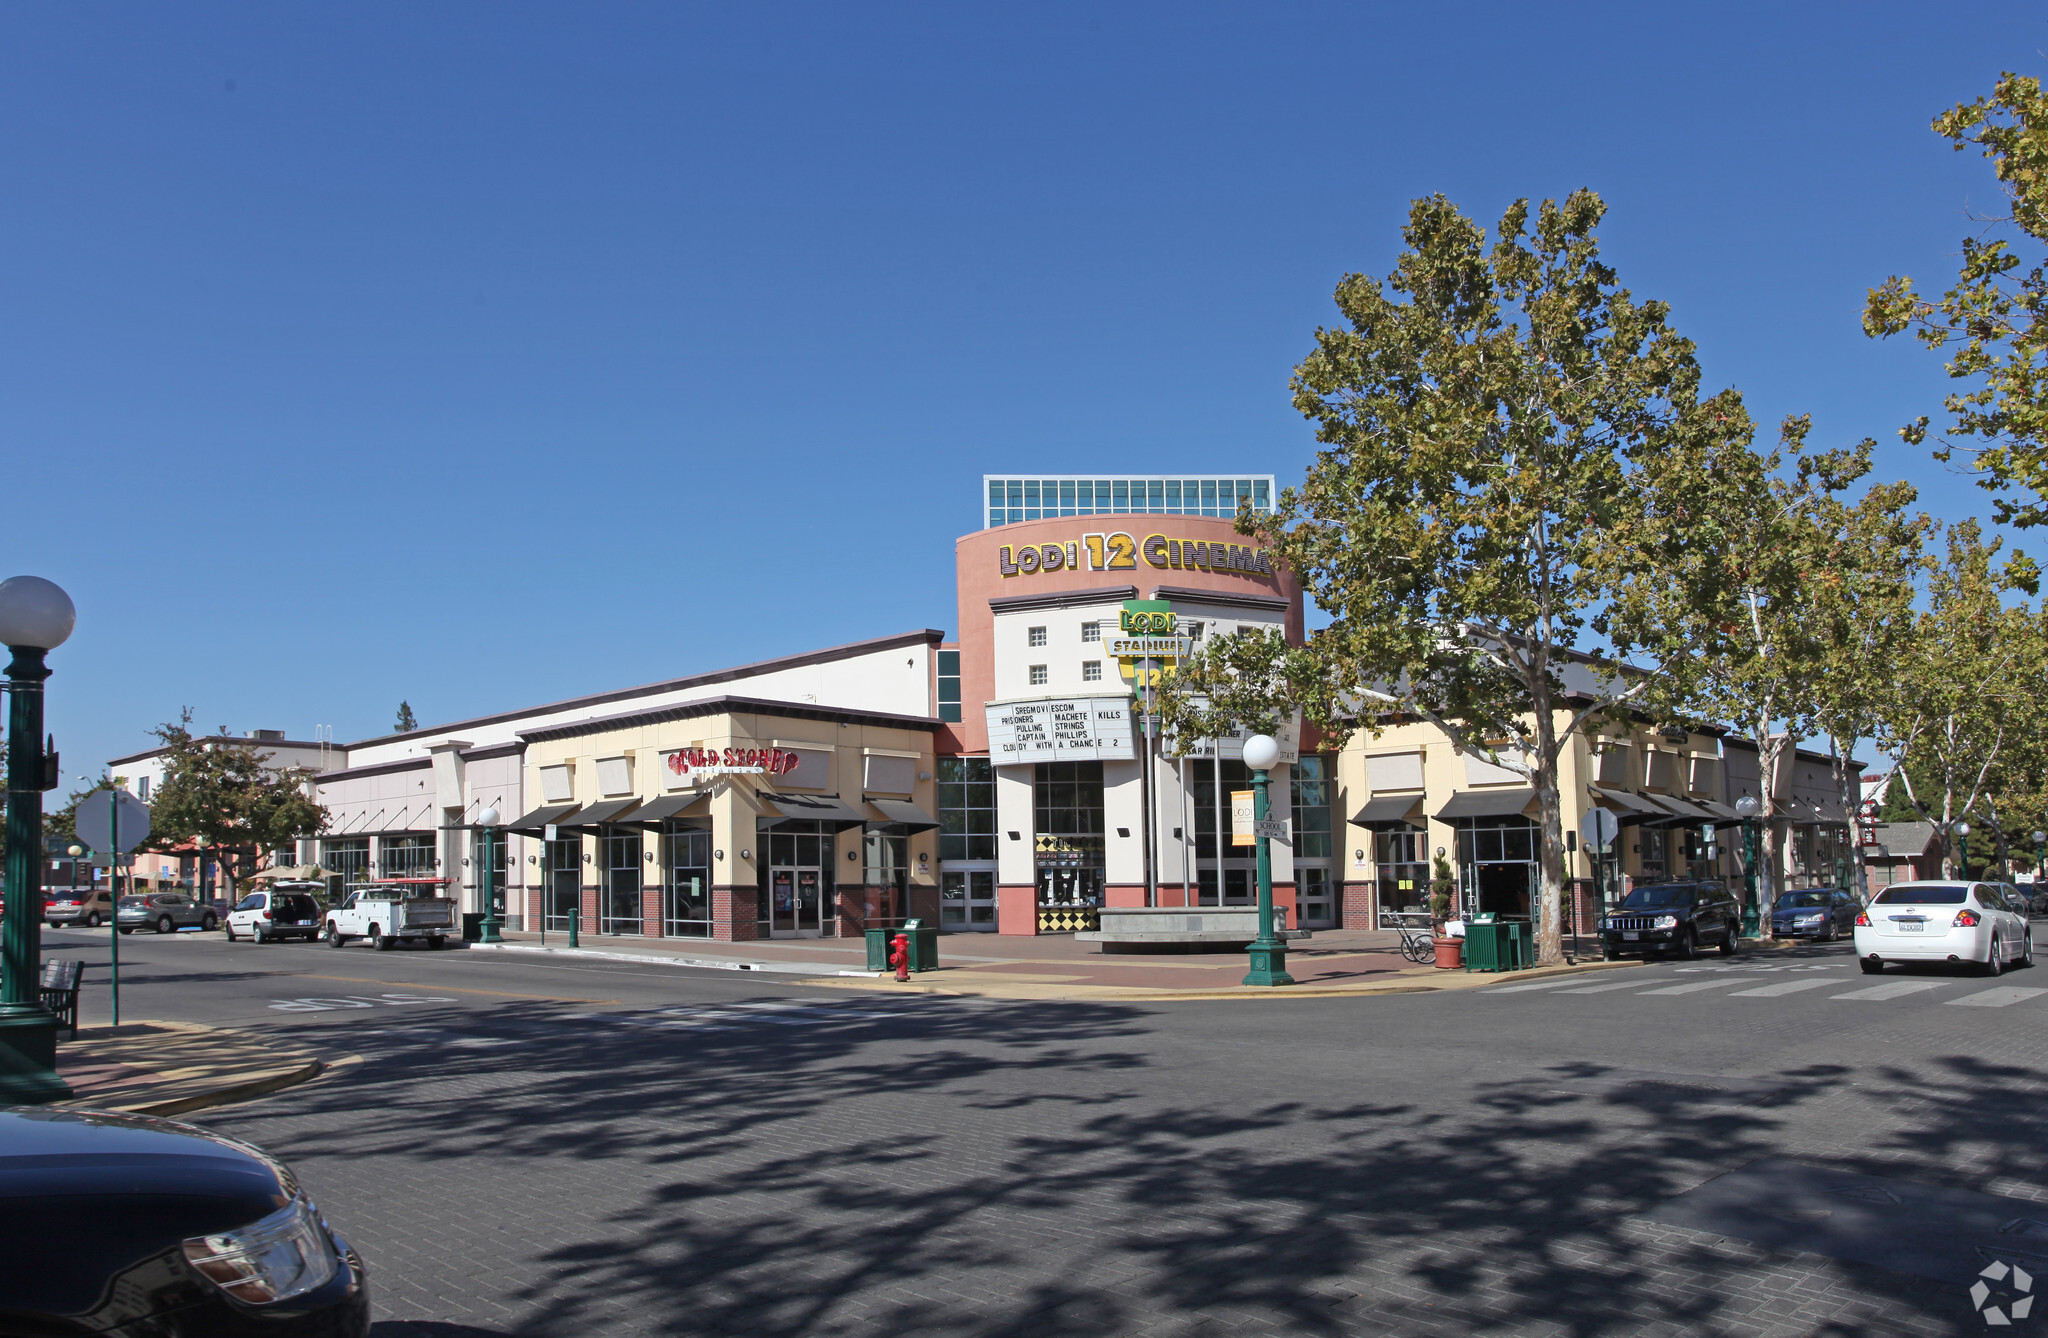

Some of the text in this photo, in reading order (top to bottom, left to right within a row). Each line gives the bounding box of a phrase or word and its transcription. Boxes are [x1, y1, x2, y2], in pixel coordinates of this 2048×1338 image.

[1000, 540, 1079, 578] LODI
[1082, 531, 1137, 571] 12
[1119, 609, 1176, 632] LODI
[1113, 640, 1184, 652] STADIUM
[1135, 668, 1161, 687] 12
[1001, 711, 1121, 725] PRISONERS MACHETE KILLS
[1016, 721, 1085, 732] PULLING STRINGS
[1017, 730, 1088, 742] CAPTAIN PHILLIPS
[1003, 738, 1118, 752] CLOUDY WITH A CHANCE 2
[679, 747, 783, 774] COLD STONE
[1233, 807, 1253, 817] LODI
[1259, 821, 1281, 831] SCHOOL
